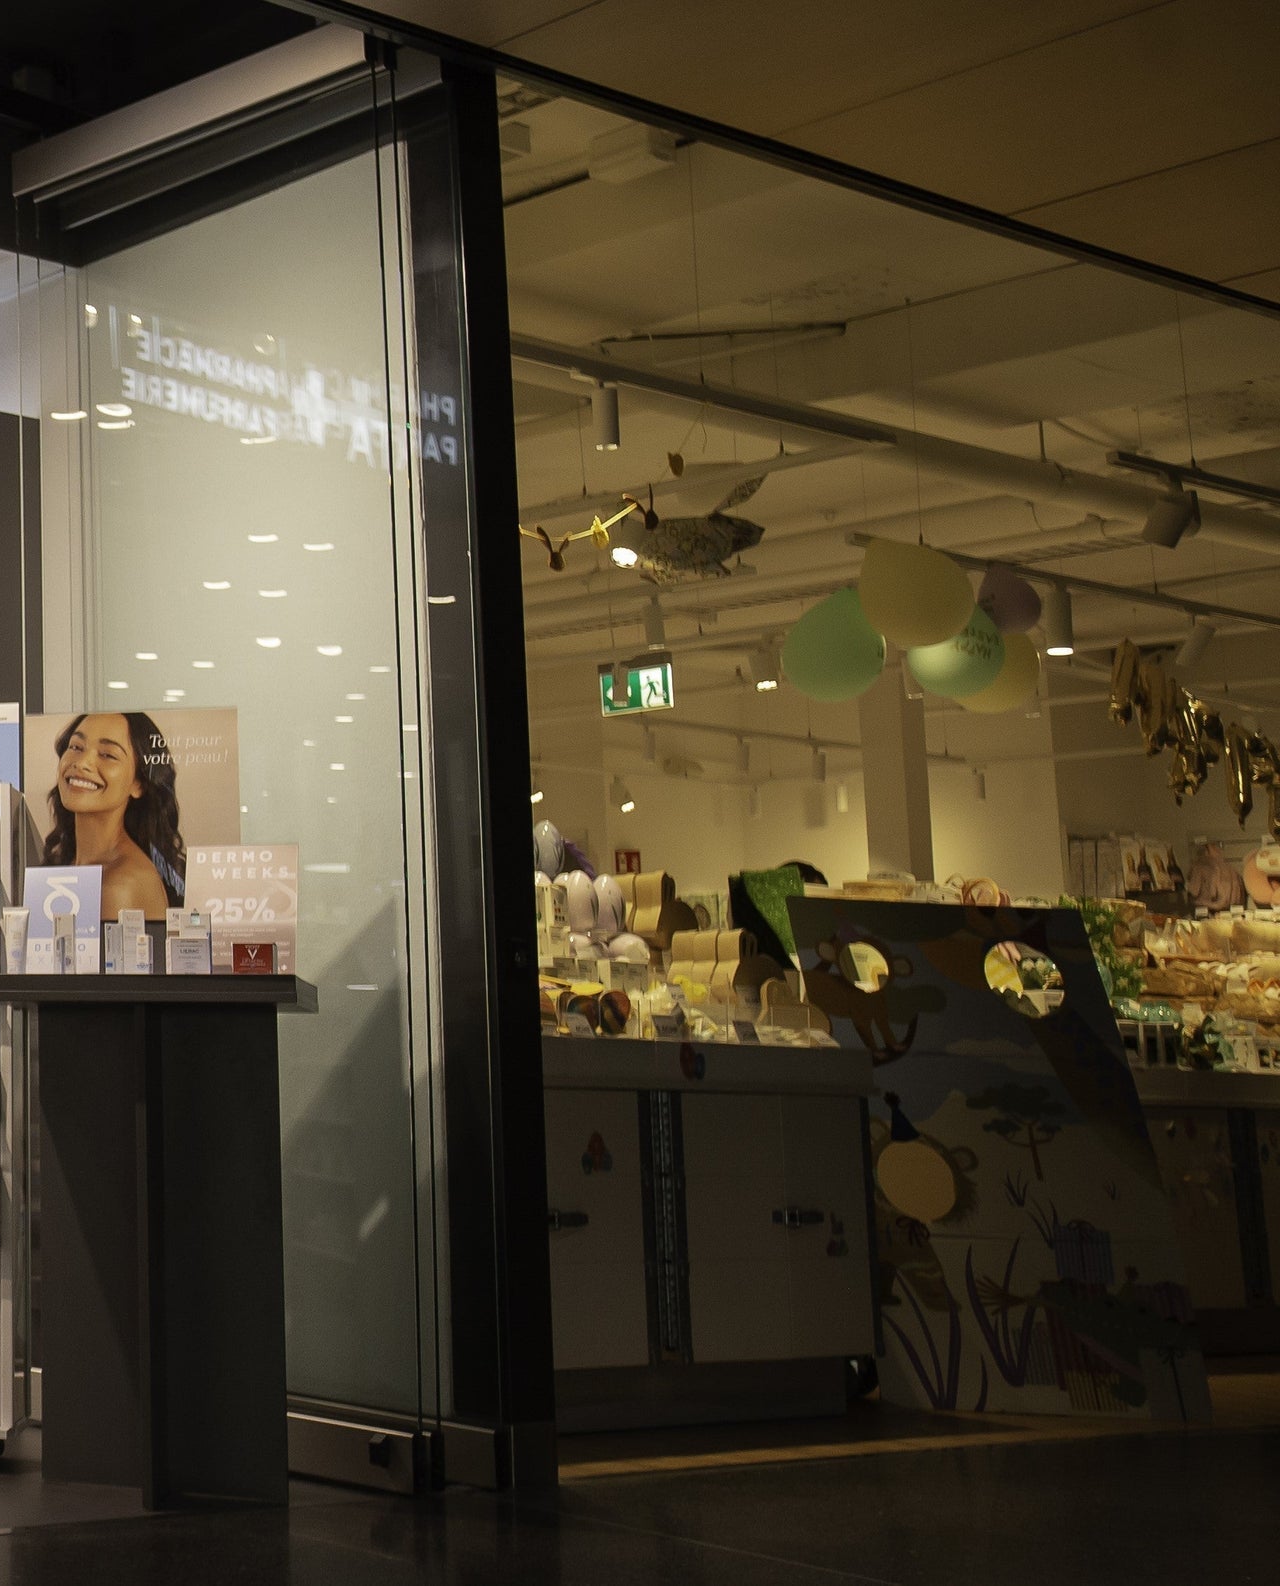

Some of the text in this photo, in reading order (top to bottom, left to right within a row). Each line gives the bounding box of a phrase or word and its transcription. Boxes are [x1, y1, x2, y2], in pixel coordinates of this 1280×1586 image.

[149, 733, 222, 750] Tout pour
[143, 752, 182, 766] votre
[196, 850, 273, 864] DERMO
[211, 866, 289, 880] WEEKS
[204, 896, 276, 923] 25%
